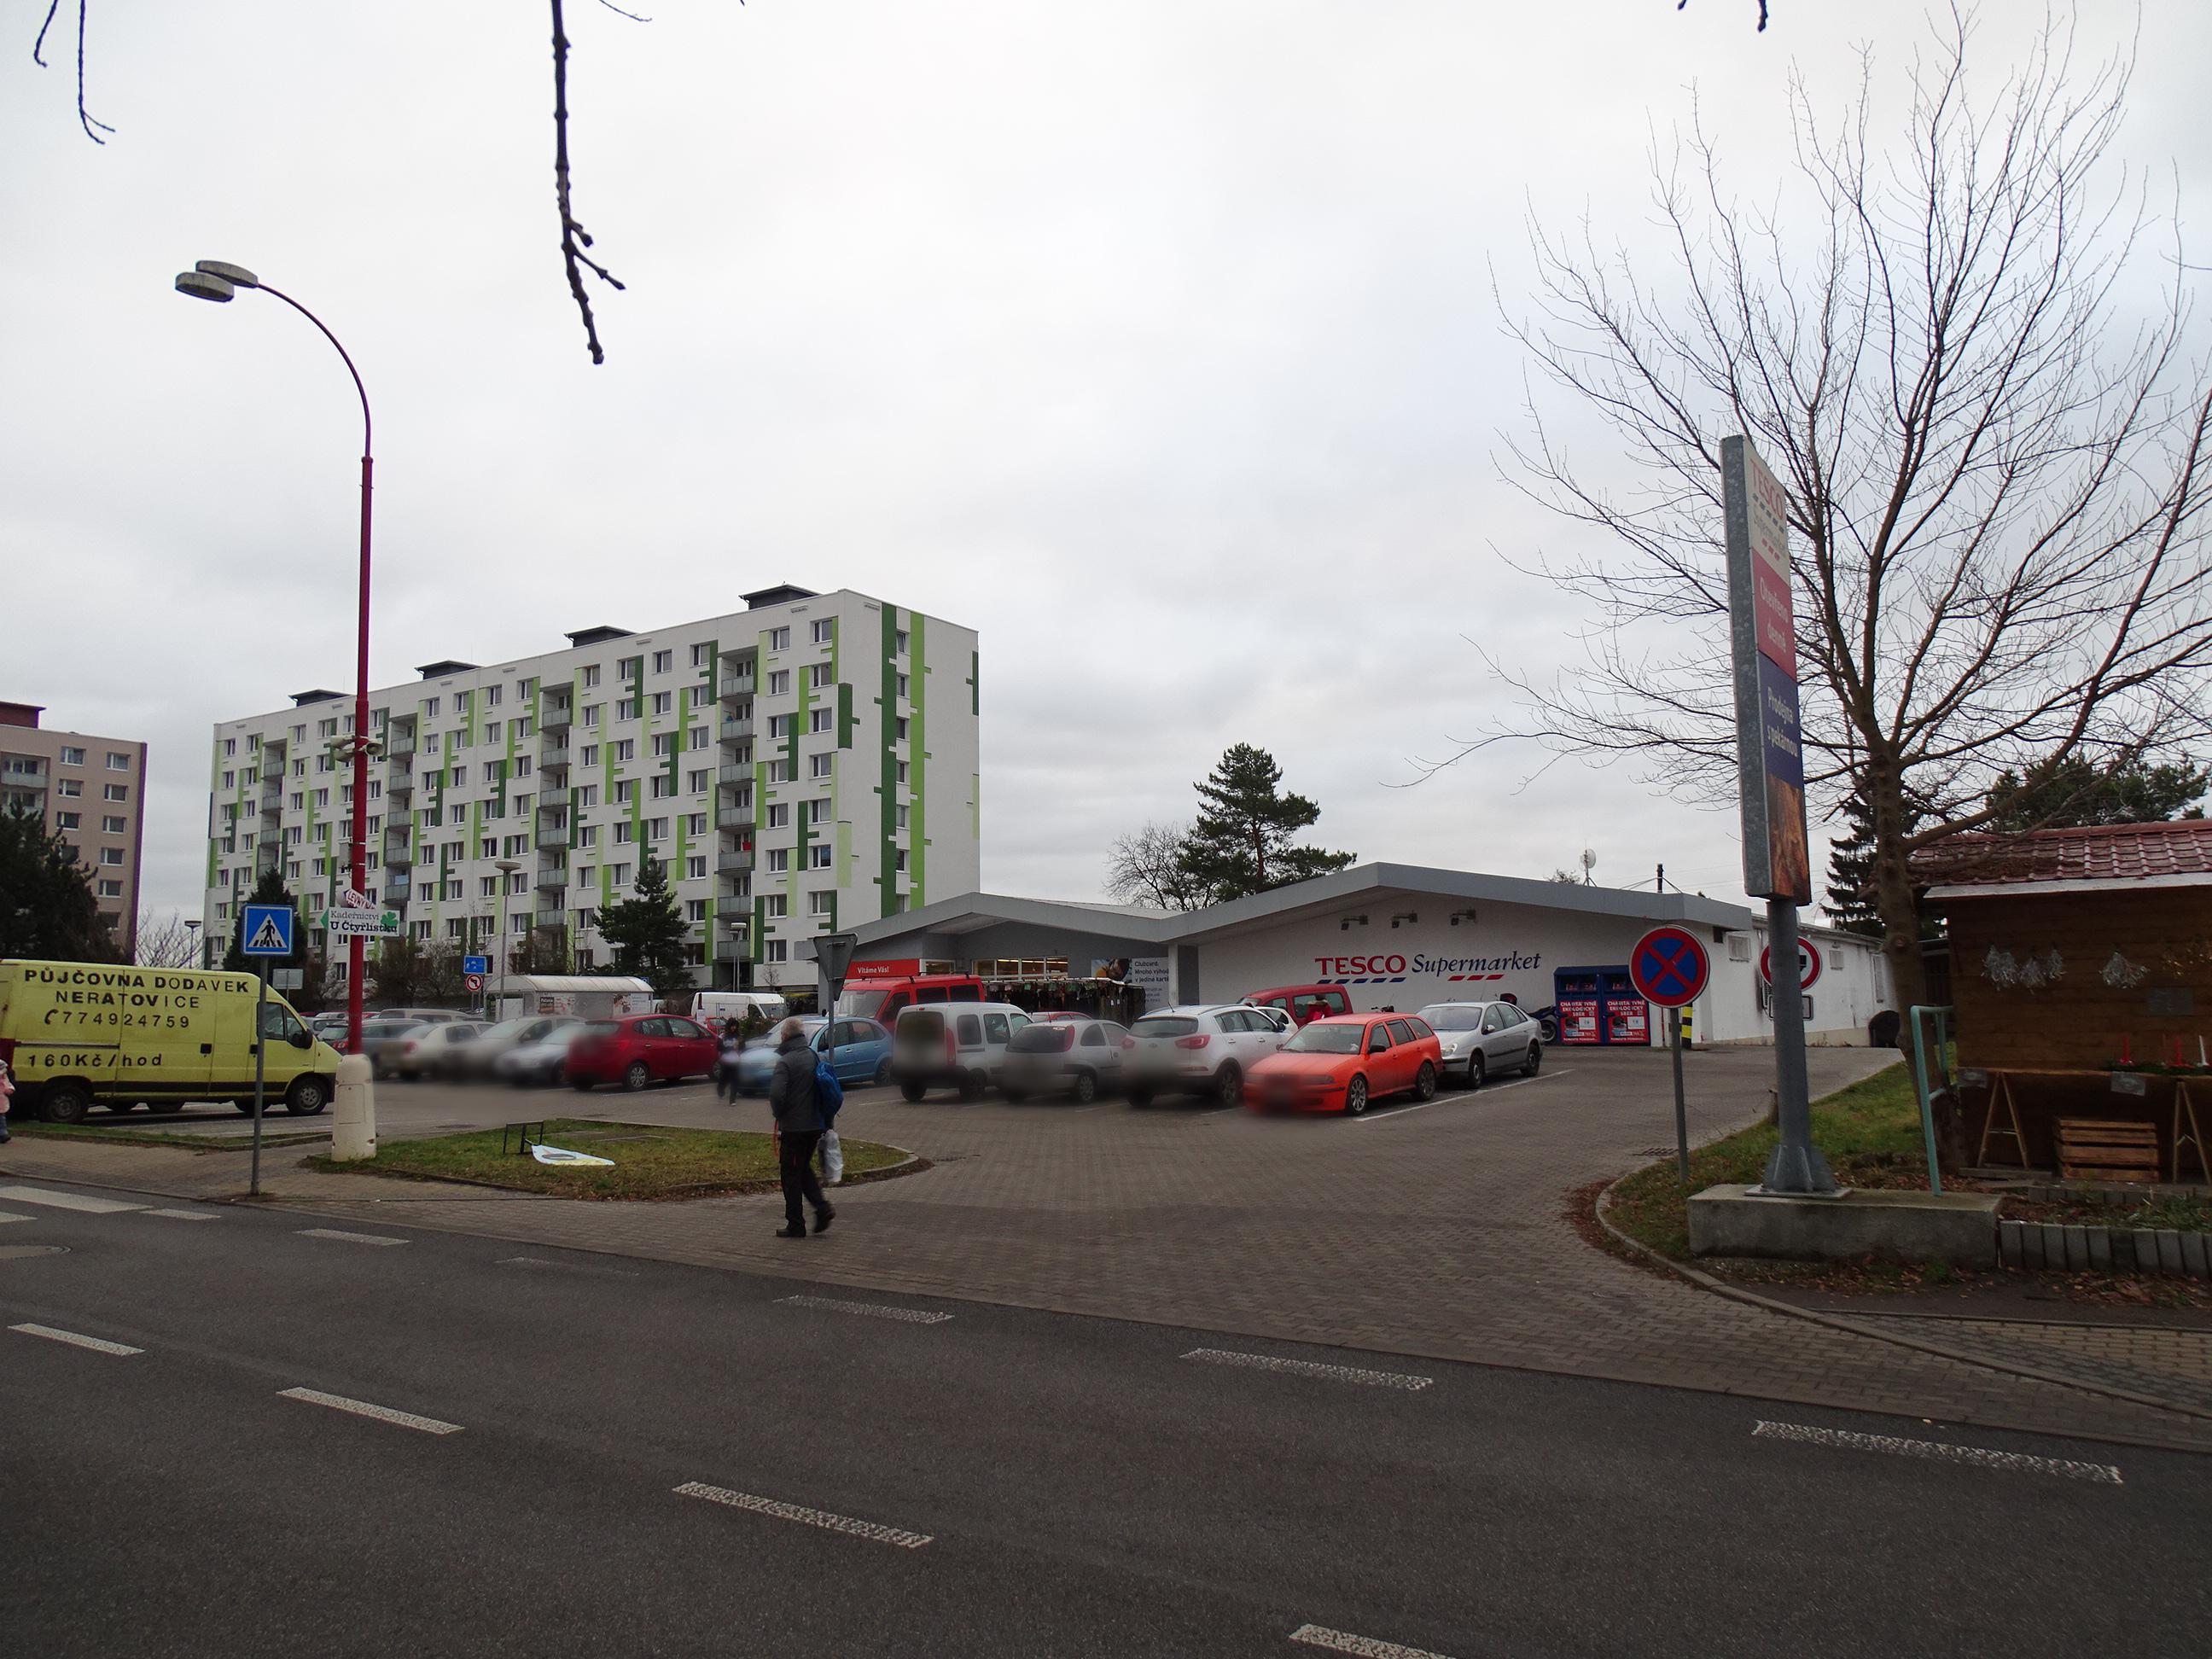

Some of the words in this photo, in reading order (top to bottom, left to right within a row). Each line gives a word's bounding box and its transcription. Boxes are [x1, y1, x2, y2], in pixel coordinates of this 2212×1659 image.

[1750, 457, 1783, 521] TESCO
[1767, 686, 1793, 724] Prodejna
[1772, 726, 1798, 758] pekárnou
[330, 921, 340, 930] U
[341, 920, 398, 933] Čtyřlístku
[1314, 955, 1406, 975] TESCO
[1412, 951, 1542, 977] Supermarket
[25, 968, 145, 987] PŮJČOVNA
[154, 976, 249, 993] DODAVEK
[55, 990, 200, 1009] NERATOVICE
[63, 1011, 189, 1028] 774924759
[29, 1054, 162, 1068] 160Kč/hod
